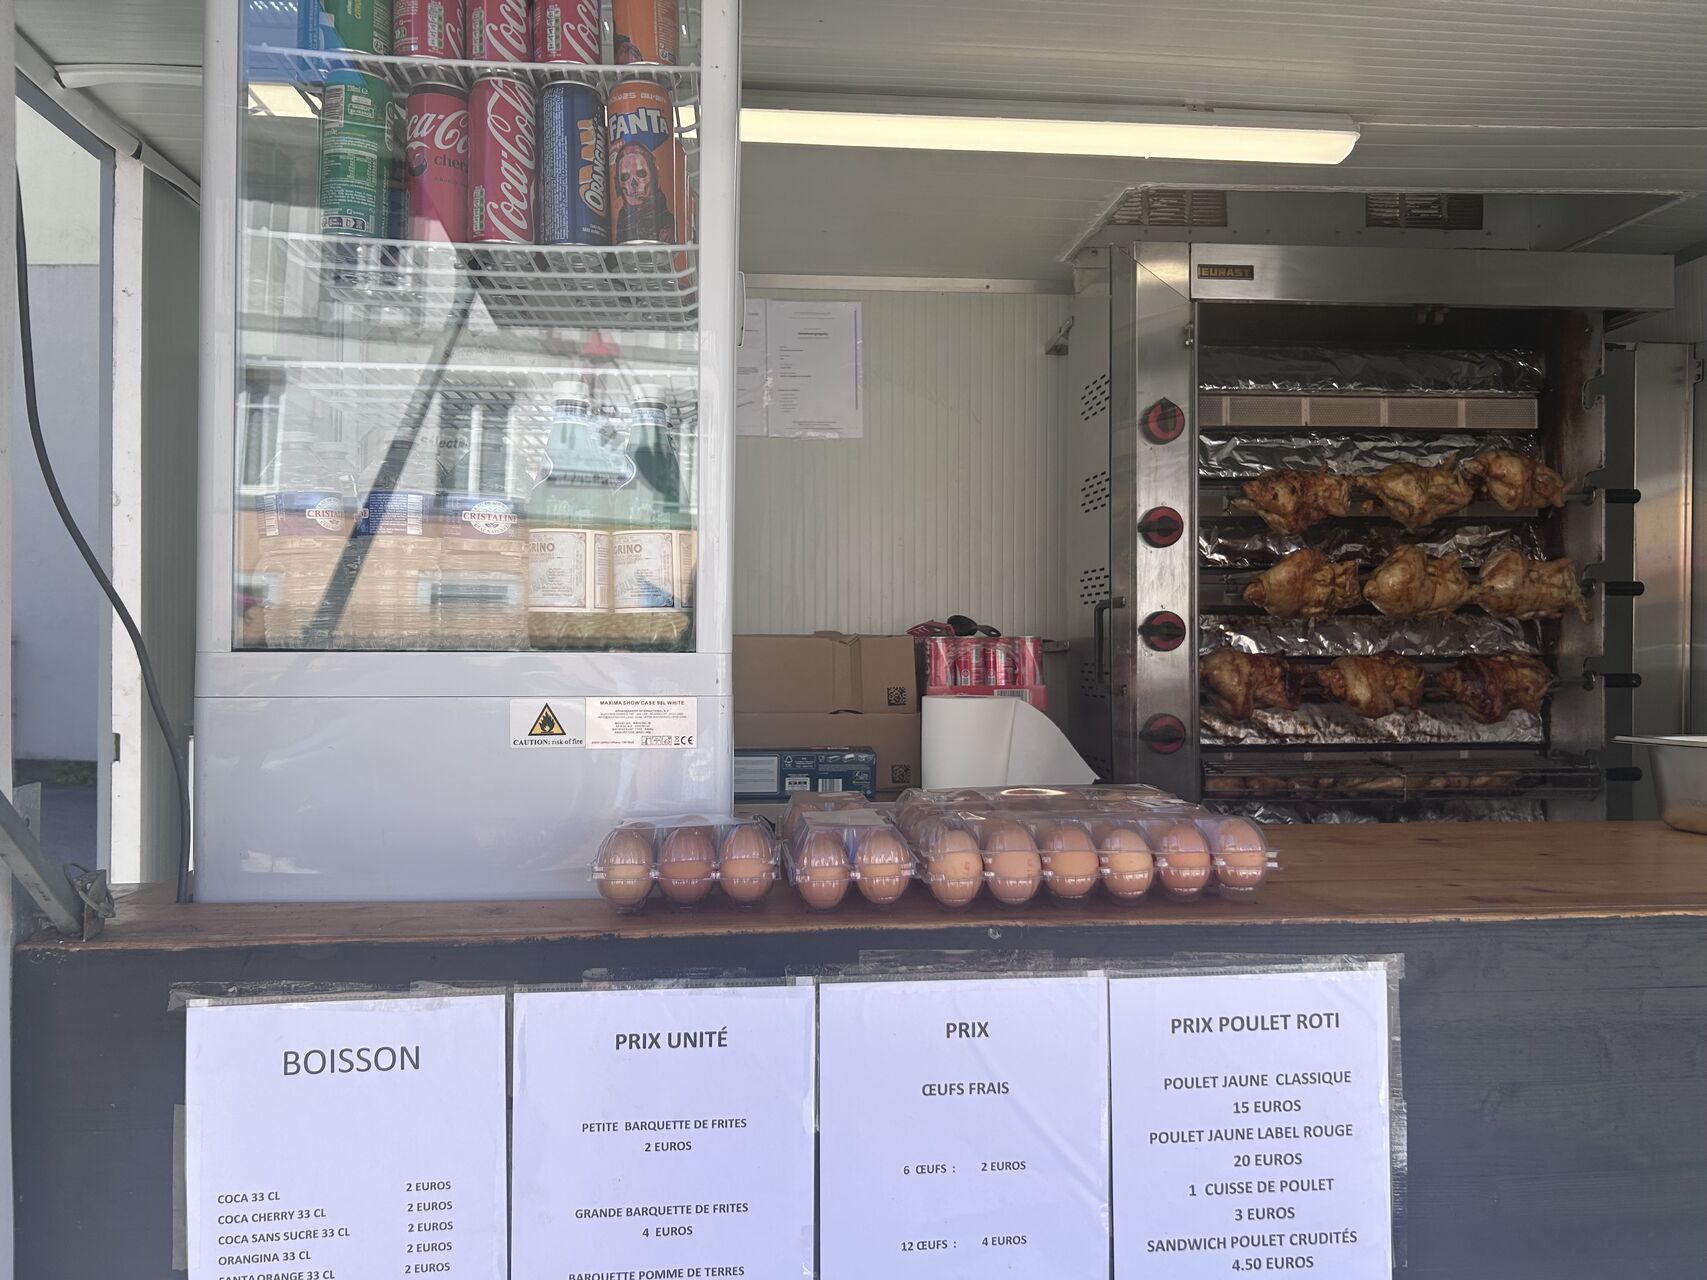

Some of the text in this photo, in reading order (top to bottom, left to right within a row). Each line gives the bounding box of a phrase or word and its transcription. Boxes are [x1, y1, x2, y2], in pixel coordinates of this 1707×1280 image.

[609, 108, 670, 142] FANTA
[434, 154, 469, 172] cher
[946, 1021, 990, 1039] PRIX
[1171, 1012, 1340, 1035] PRIX POULET ROTI
[615, 1026, 728, 1051] PRIX UNITÉ
[283, 1045, 421, 1076] BOISSON
[922, 1081, 1010, 1097] ŒUFS FRAIS
[1164, 1070, 1352, 1091] POULET JAUNE CLASSIQUE
[1233, 1099, 1302, 1114] 15 EUROS
[582, 1118, 748, 1133] PETITE BARQUETTE DE FRITES
[1150, 1123, 1354, 1145] POULET JAUNE LABEL ROUGE
[645, 1140, 693, 1153] 2 EUROS
[903, 1165, 911, 1176] 6
[915, 1163, 947, 1175] ŒUFS
[980, 1162, 988, 1172] 2
[990, 1160, 1027, 1172] EUROS
[1234, 1152, 1303, 1168] 20 EUROS
[217, 1180, 452, 1205] COCA 33 CL 2 EUROS
[1189, 1177, 1335, 1197] 1 CUISSE DE POULET
[217, 1200, 453, 1225] COCA CHERRY 33 CL 2 EUROS
[575, 1202, 749, 1219] GRANDE BARQUETTE DE FRITES
[1235, 1206, 1296, 1222] 3 EUROS
[217, 1220, 454, 1246] COCA SANS SUCRE 33 CL 2 EUROS
[642, 1225, 694, 1238] 4 EUROS
[1147, 1228, 1358, 1253] SANDWICH POULET CRUDITÉS
[901, 1241, 914, 1252] 12
[916, 1239, 948, 1251] ŒUFS
[981, 1236, 989, 1246] 4
[991, 1235, 1028, 1247] EUROS
[218, 1241, 453, 1266] ORANGINA 33 CL 2 EUROS
[306, 1270, 320, 1280] 33
[322, 1269, 336, 1280] CL
[404, 1264, 412, 1275] 2
[415, 1261, 451, 1274] EUROS
[1232, 1255, 1315, 1272] 4.50 EUROS
[638, 1268, 684, 1280] POMME
[687, 1267, 701, 1278] DE
[704, 1266, 745, 1277] TERRES
